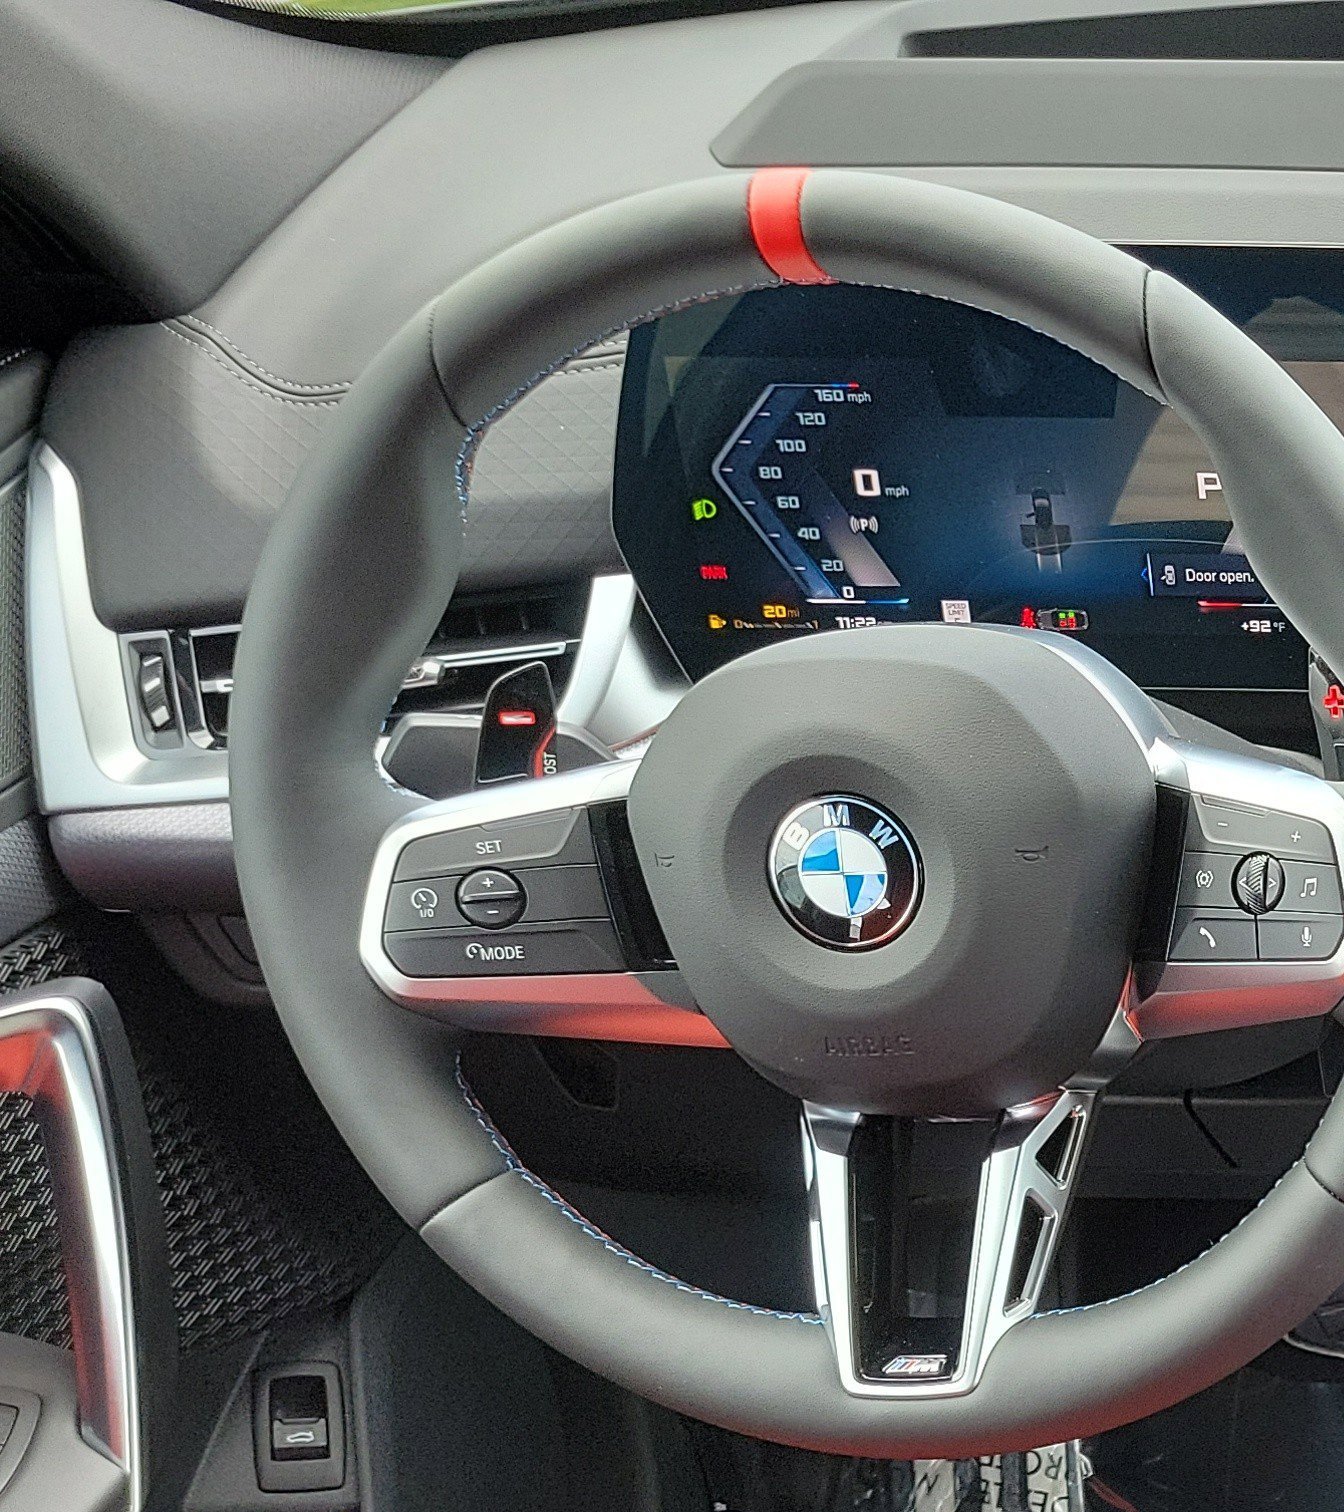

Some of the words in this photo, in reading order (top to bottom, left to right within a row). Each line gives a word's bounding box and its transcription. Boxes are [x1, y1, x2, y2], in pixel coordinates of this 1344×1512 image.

[814, 389, 844, 403] 160
[847, 392, 872, 404] mph
[795, 412, 826, 426] 120
[775, 439, 807, 453] 100
[758, 466, 782, 480] 80
[852, 468, 882, 497] 0
[885, 487, 910, 499] mph
[1196, 472, 1223, 500] P
[776, 495, 801, 510] 60
[797, 527, 820, 541] 40
[820, 559, 845, 573] 20
[1185, 568, 1217, 583] Door
[1219, 571, 1255, 585] open.
[841, 586, 855, 599] 0
[762, 604, 787, 618] 20
[835, 616, 877, 629] 11:22
[1240, 619, 1272, 633] +92
[543, 751, 557, 775] OST
[782, 804, 899, 851] BMW
[475, 840, 502, 855] SET
[481, 945, 525, 961] MODE
